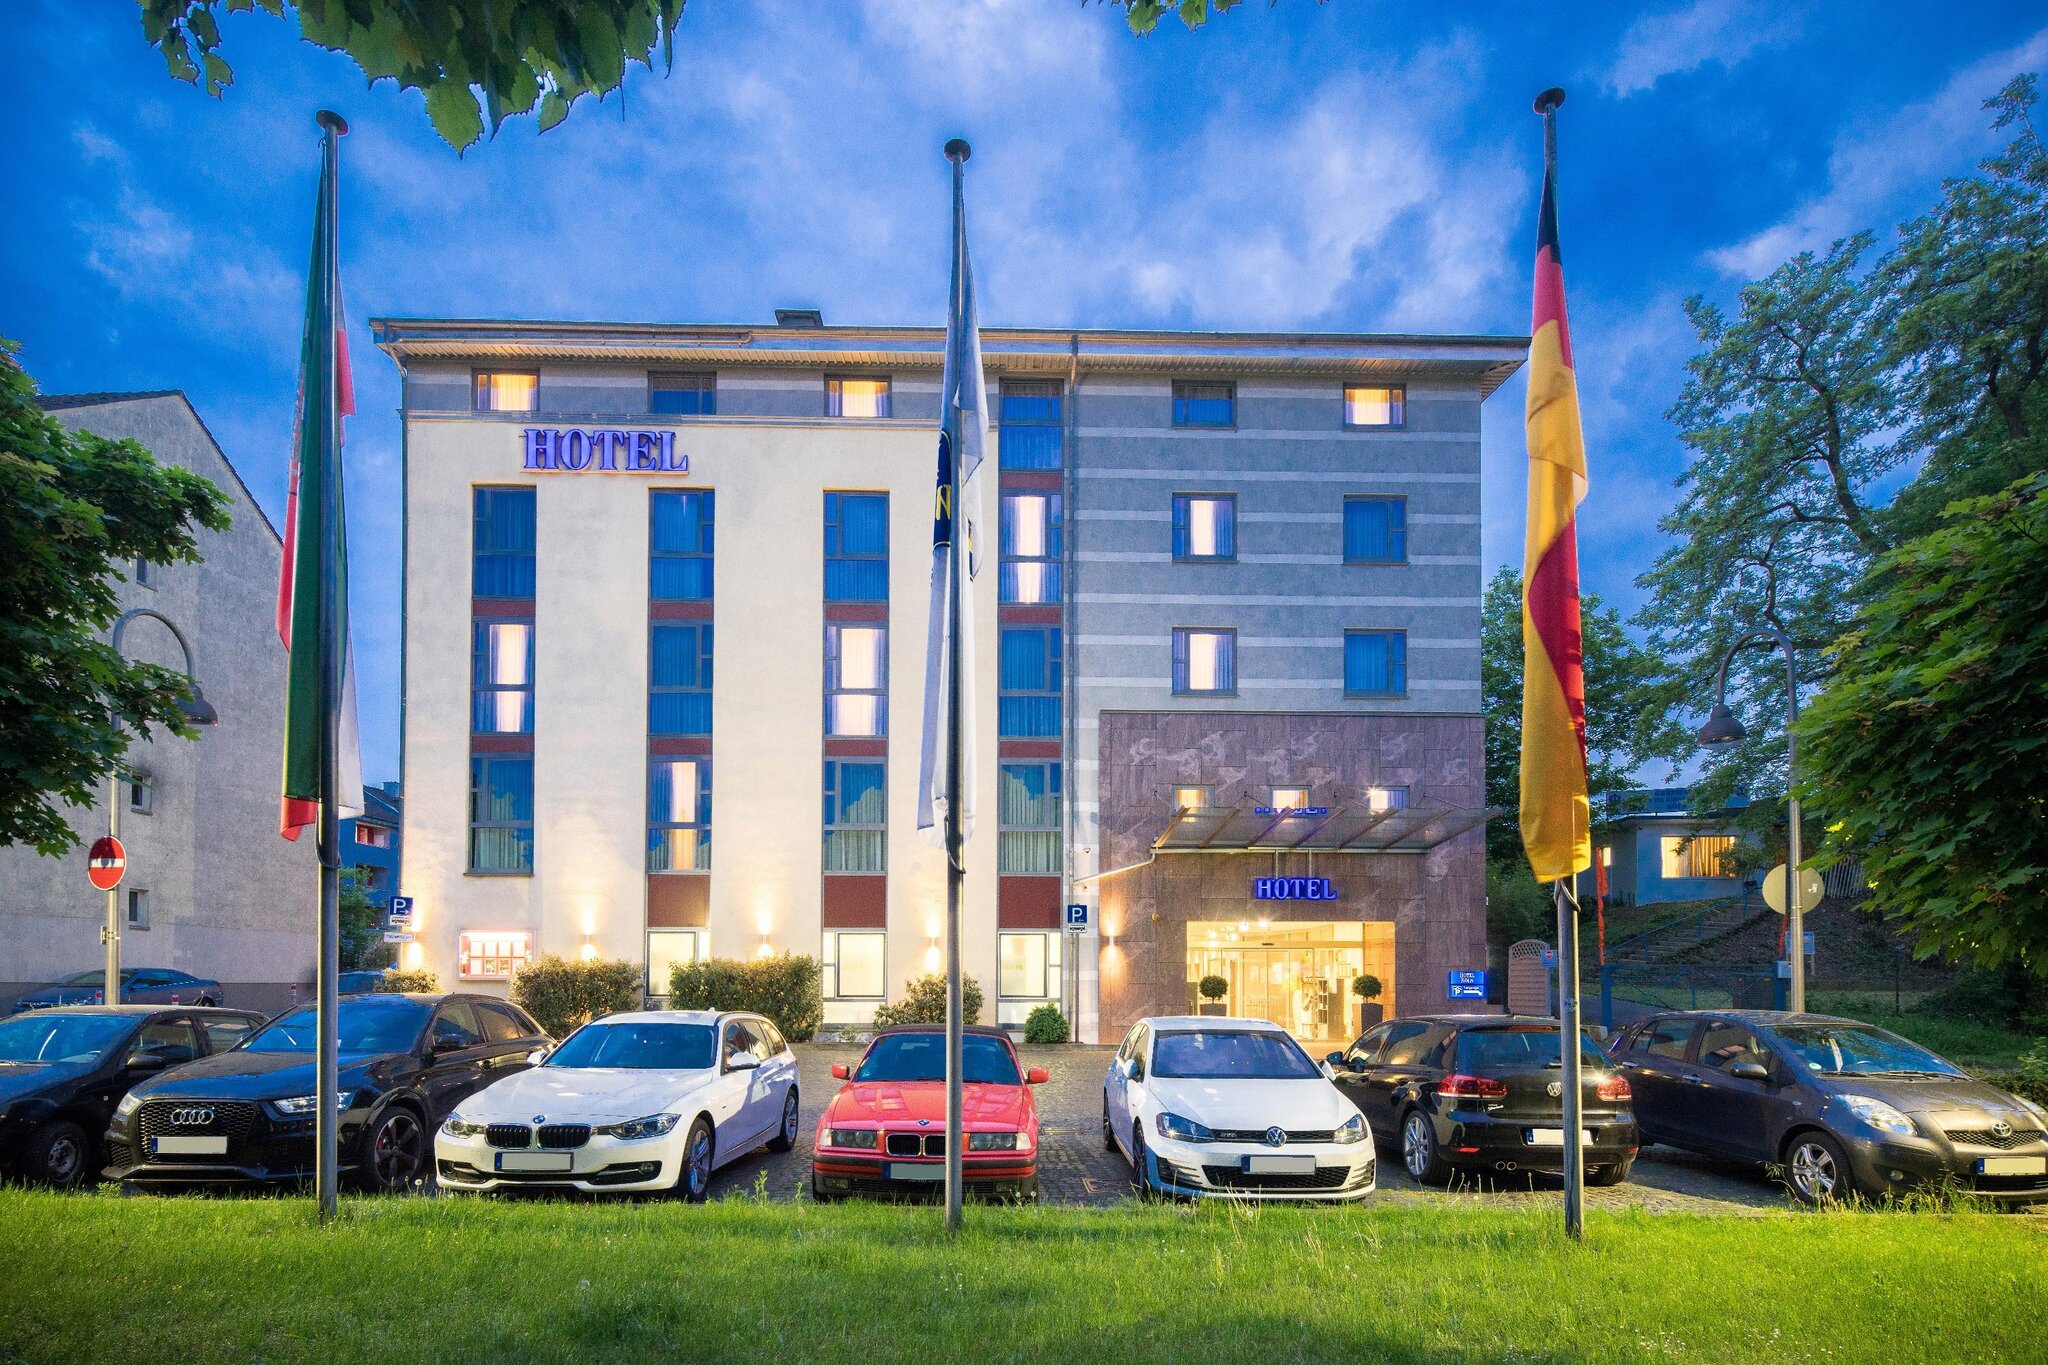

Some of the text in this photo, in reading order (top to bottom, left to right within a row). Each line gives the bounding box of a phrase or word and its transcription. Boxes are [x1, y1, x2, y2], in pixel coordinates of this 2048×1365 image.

[524, 429, 689, 471] HOTEL
[1256, 878, 1337, 899] HOTEL
[393, 898, 406, 914] P
[1072, 907, 1083, 922] P
